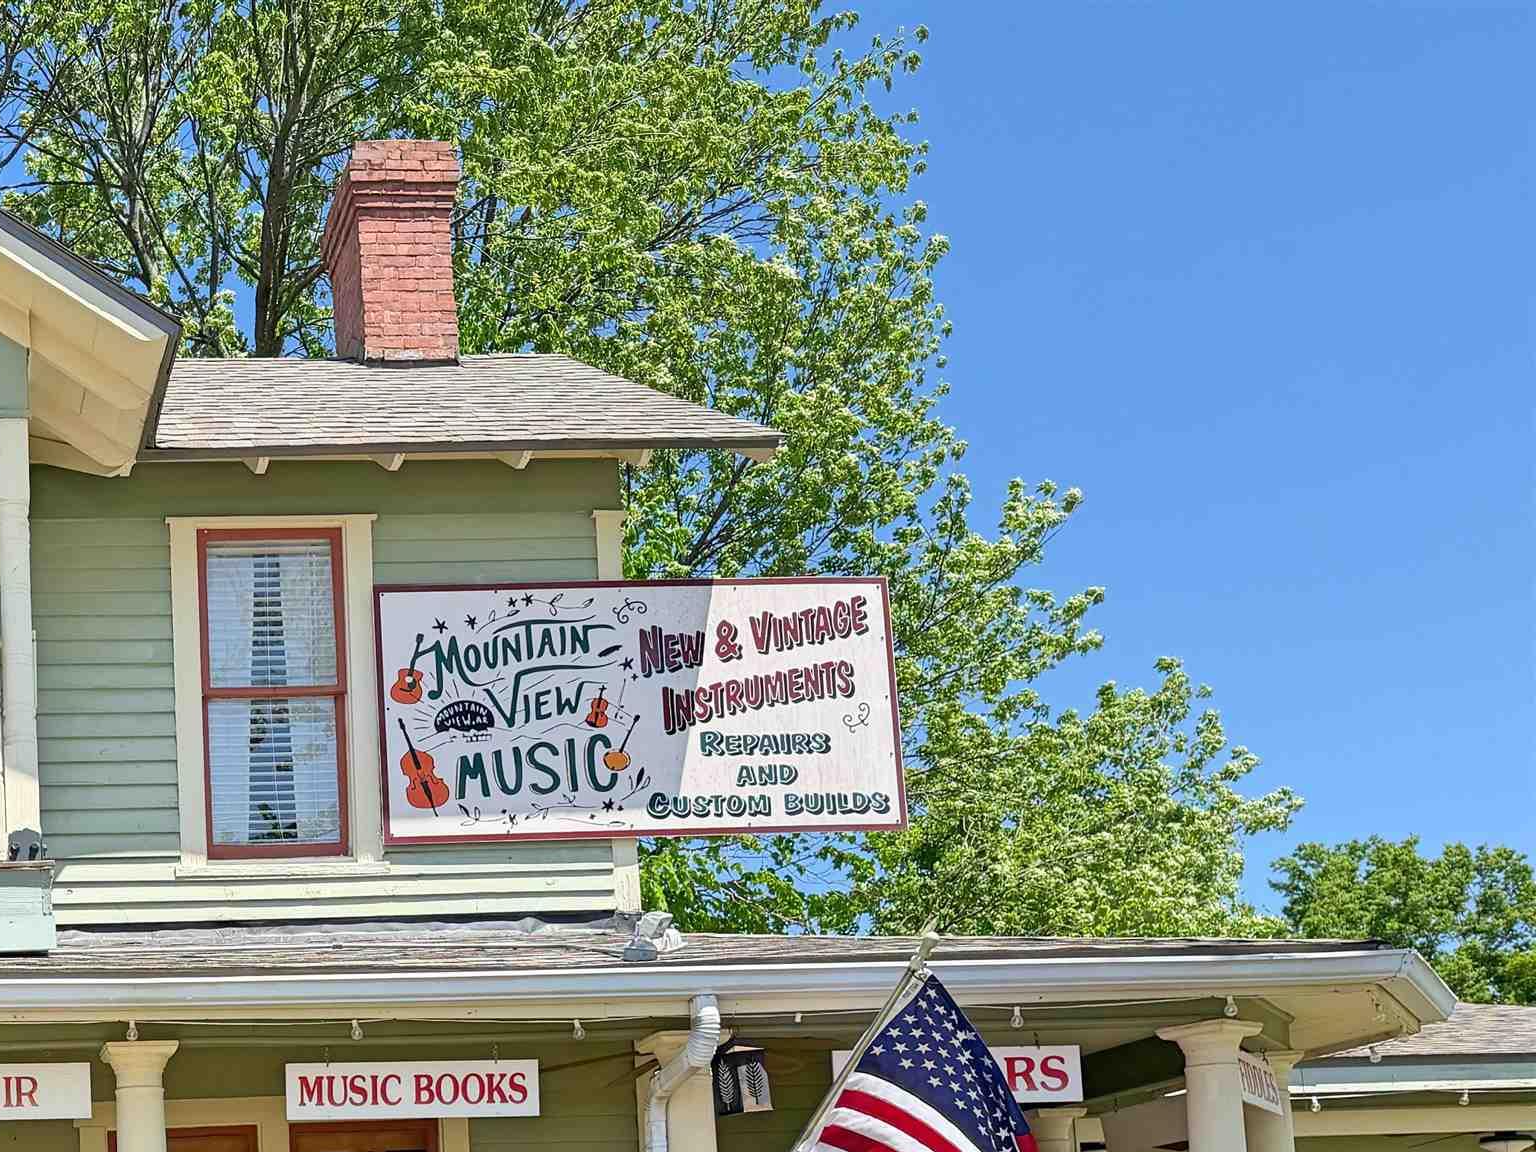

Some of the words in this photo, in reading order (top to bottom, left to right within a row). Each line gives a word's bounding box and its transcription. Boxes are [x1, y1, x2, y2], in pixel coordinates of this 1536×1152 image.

[420, 620, 612, 690] MOUNTAIN
[638, 625, 706, 677] NEW
[715, 620, 743, 661] &
[748, 596, 869, 653] VINTAGE
[483, 668, 588, 728] VIEW
[662, 659, 855, 735] INSTRUMENTS
[455, 734, 618, 799] MUSIC
[699, 731, 831, 757] REPAIRS
[646, 792, 771, 818] CUSTOM
[784, 791, 891, 816] BUILDS
[736, 763, 797, 787] AND
[298, 1073, 402, 1107] MUSIC
[414, 1072, 528, 1105] BOOKS
